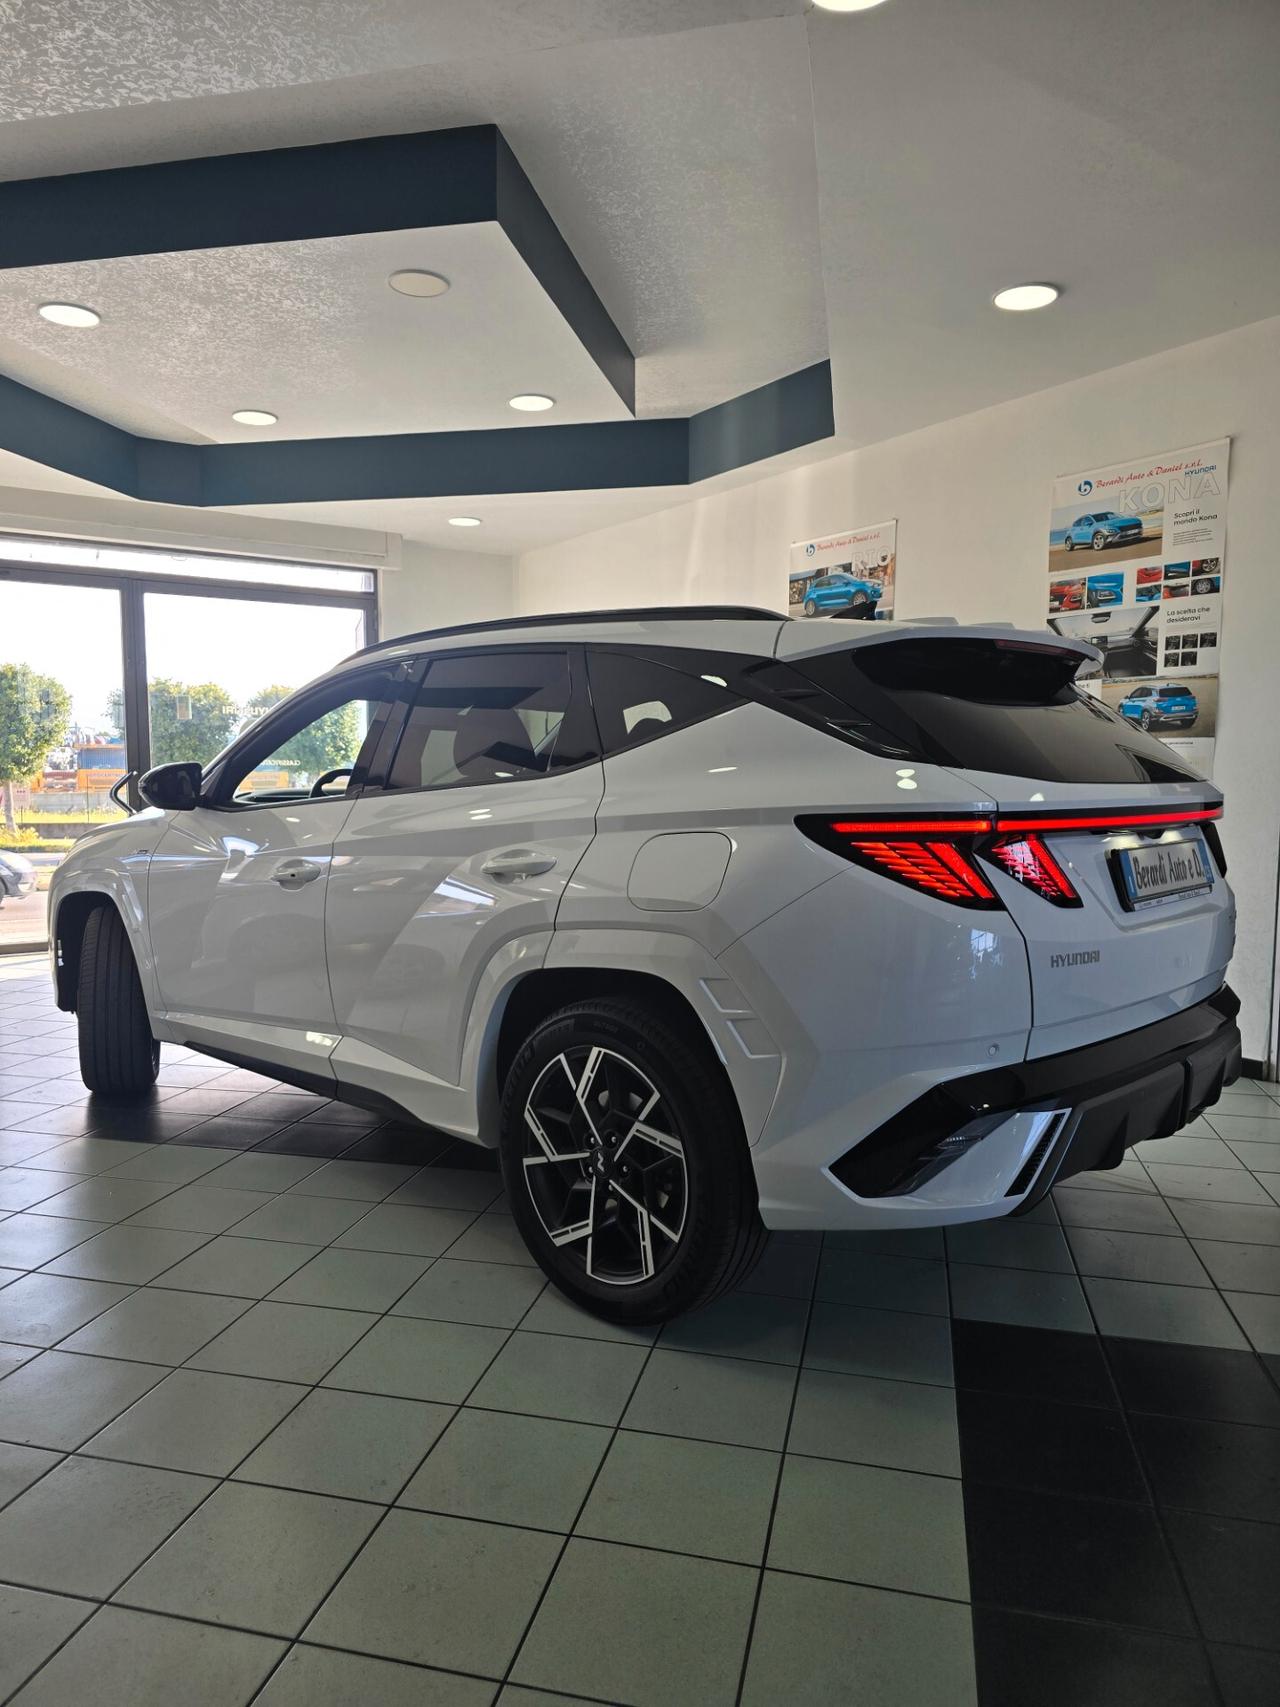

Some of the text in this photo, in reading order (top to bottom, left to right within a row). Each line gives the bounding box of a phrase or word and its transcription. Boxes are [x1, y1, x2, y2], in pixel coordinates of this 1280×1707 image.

[1096, 475, 1123, 488] Berardi
[1125, 472, 1145, 484] Auto
[1154, 462, 1182, 476] Daniel
[1184, 464, 1217, 477] HYUNDAI
[1119, 472, 1221, 513] KONA
[1173, 513, 1218, 526] mondo Kona
[1174, 509, 1194, 520] Scopri
[1166, 613, 1201, 623] desideravi
[1132, 852, 1168, 890] Berardi
[1167, 851, 1188, 883] Auto
[1187, 858, 1194, 880] e
[1050, 950, 1100, 968] HYUNDAI
